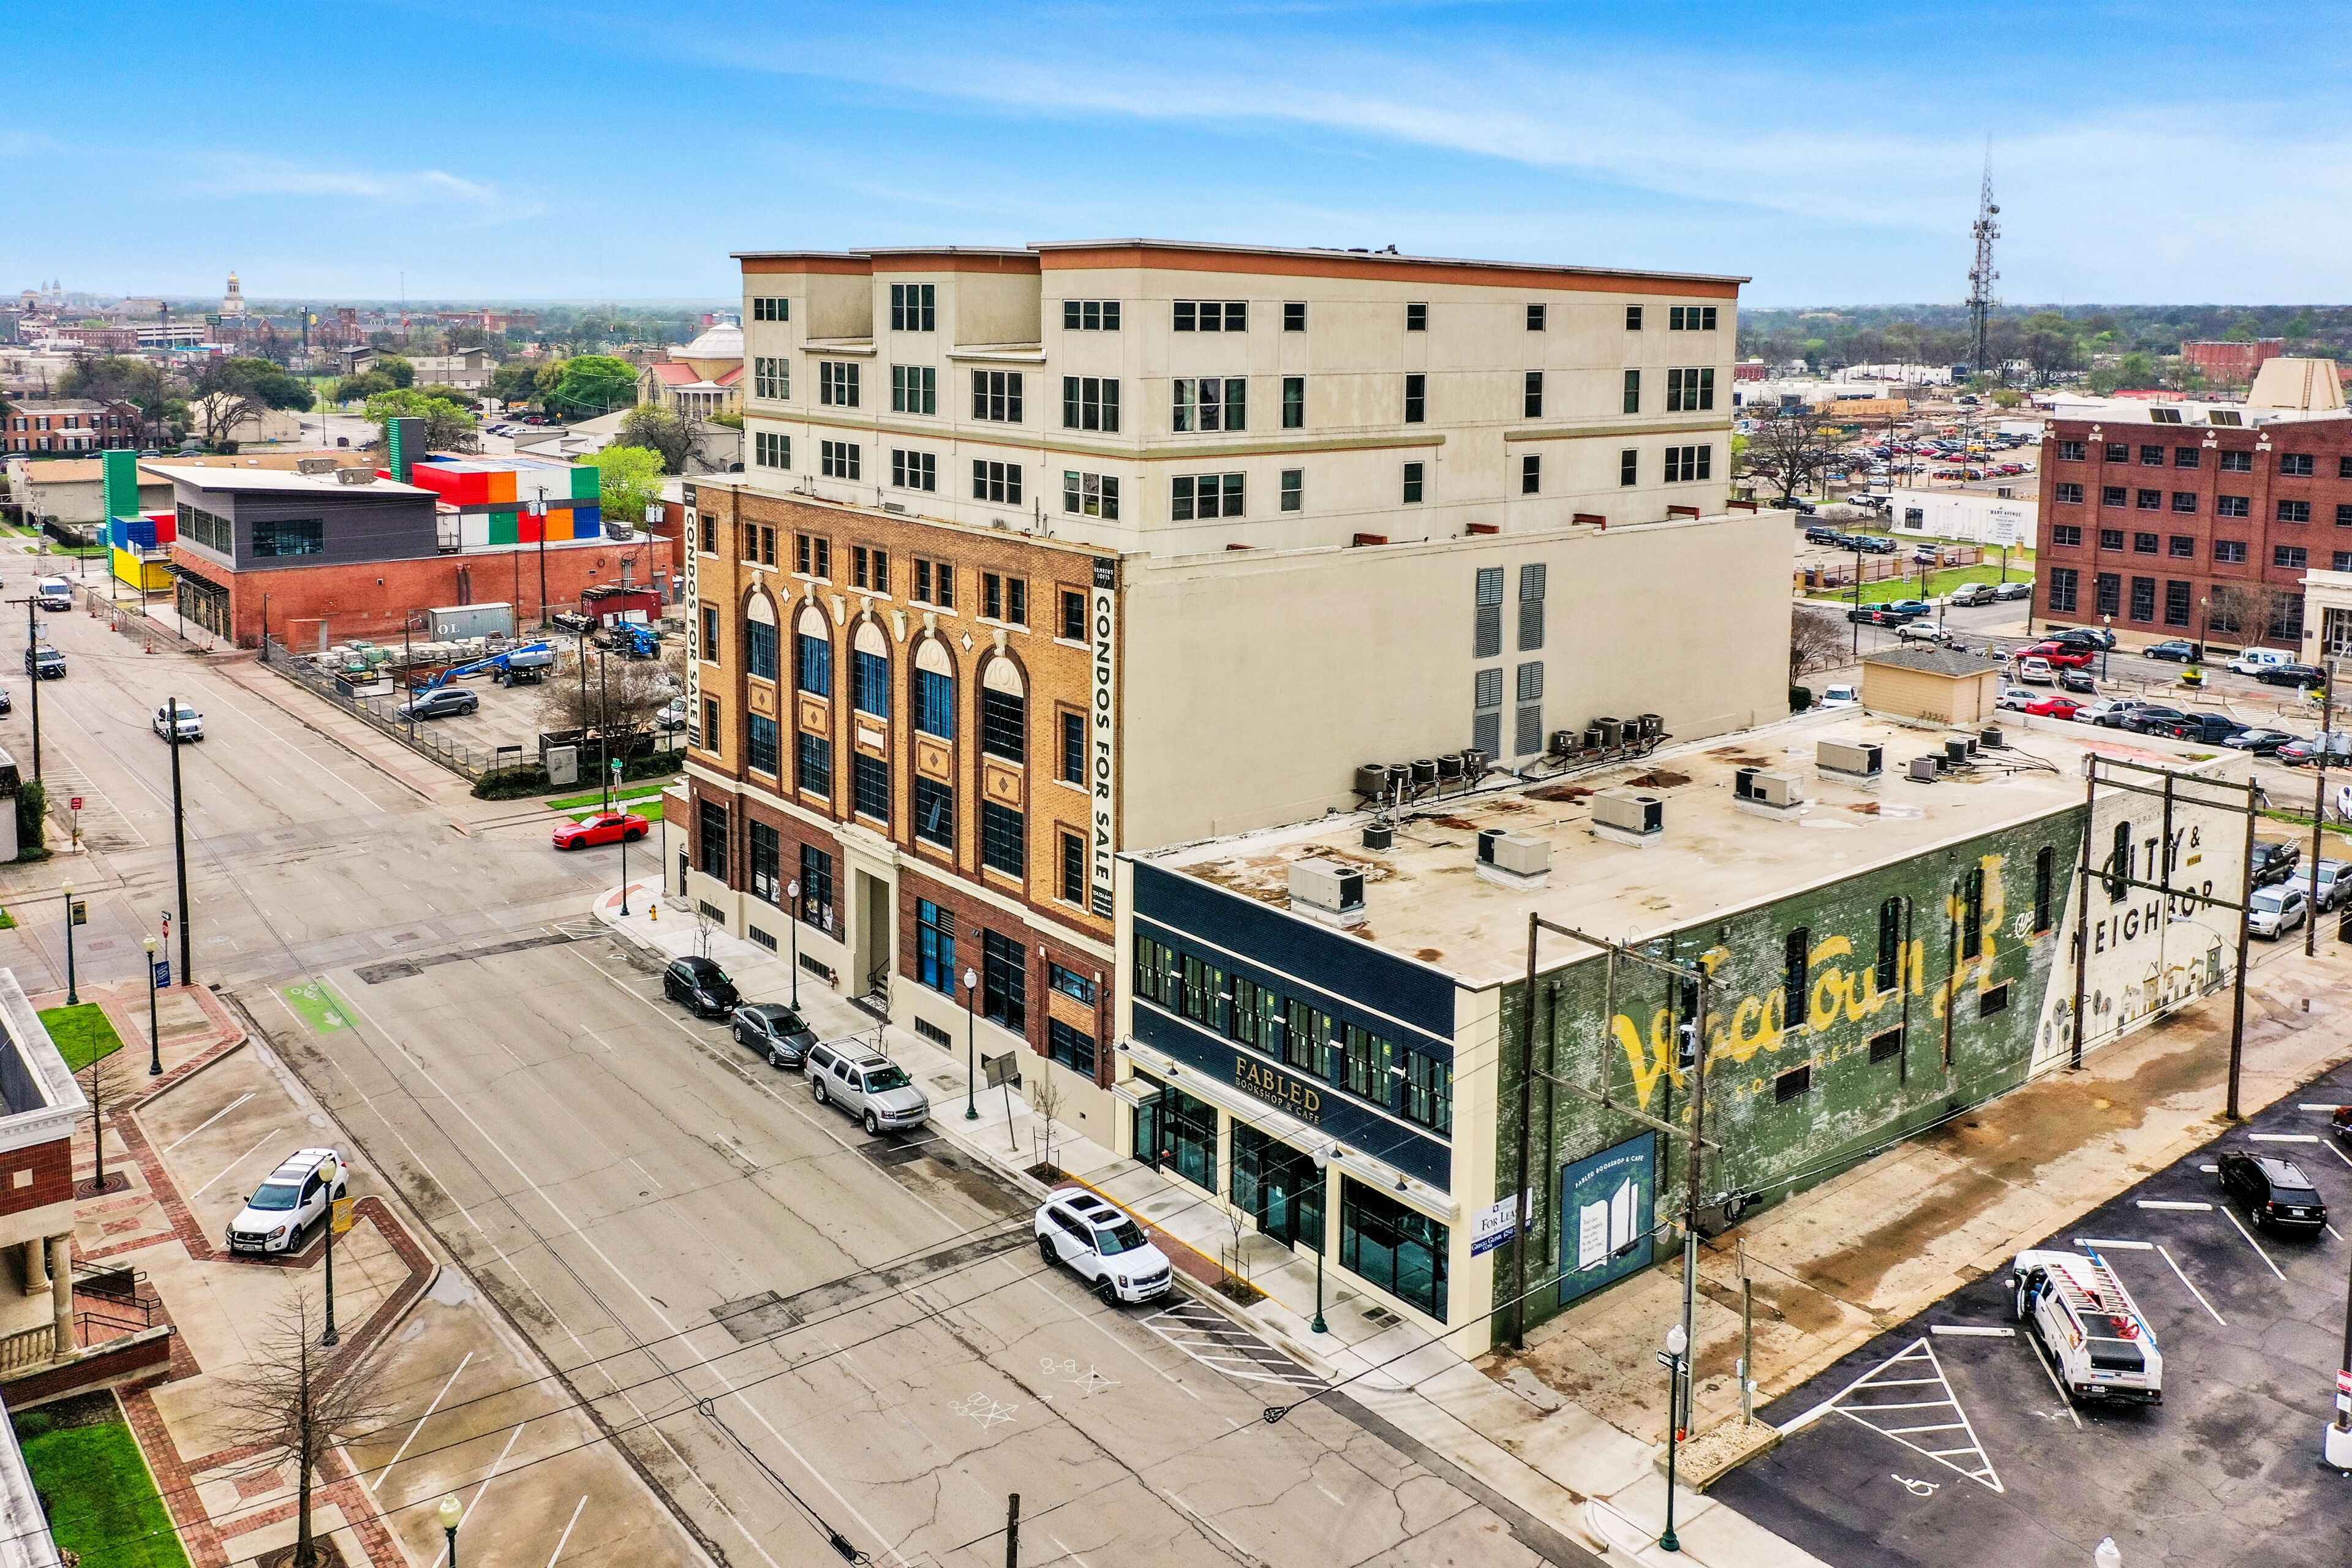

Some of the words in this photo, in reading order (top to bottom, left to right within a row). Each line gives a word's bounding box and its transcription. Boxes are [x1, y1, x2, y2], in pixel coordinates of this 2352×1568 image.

[687, 512, 696, 609] CONDOS
[688, 618, 697, 661] FOR
[1096, 595, 1110, 729] CONDOS
[1096, 740, 1109, 799] FOR
[1095, 810, 1109, 880] SALE
[1235, 1055, 1321, 1112] FABLED
[1235, 1077, 1283, 1107] BOOKSHOP
[1286, 1102, 1293, 1112] &
[1296, 1107, 1320, 1125] CAFE
[1575, 1170, 1595, 1189] FABLED
[1596, 1158, 1625, 1174] BOOKSHOP
